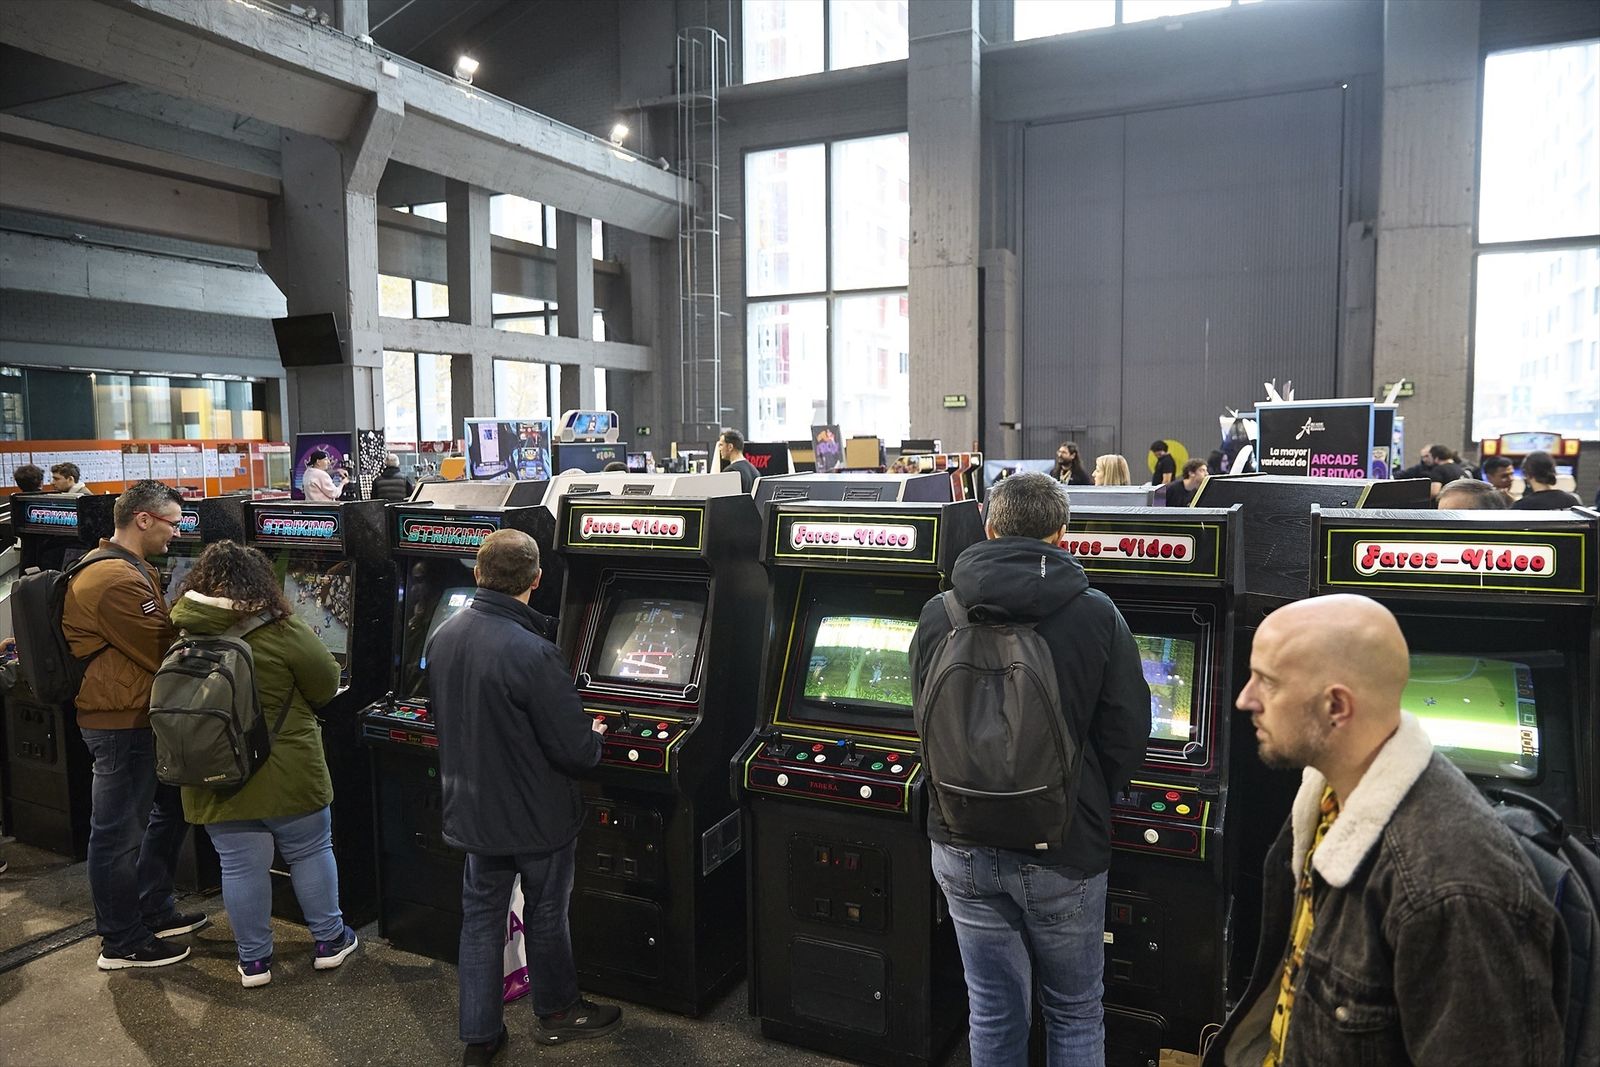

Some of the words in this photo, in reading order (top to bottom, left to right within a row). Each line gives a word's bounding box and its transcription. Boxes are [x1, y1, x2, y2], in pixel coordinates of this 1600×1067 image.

[1270, 447, 1279, 456] La
[1280, 448, 1308, 459] mayor
[1261, 457, 1296, 467] variedad
[1296, 457, 1307, 467] de
[1311, 454, 1359, 466] ARCADE
[1311, 468, 1326, 478] DE
[1328, 468, 1365, 479] RITMO
[263, 518, 335, 537] STRIKING
[1058, 537, 1187, 559] ares-Video
[1361, 544, 1546, 572] Fares-Video
